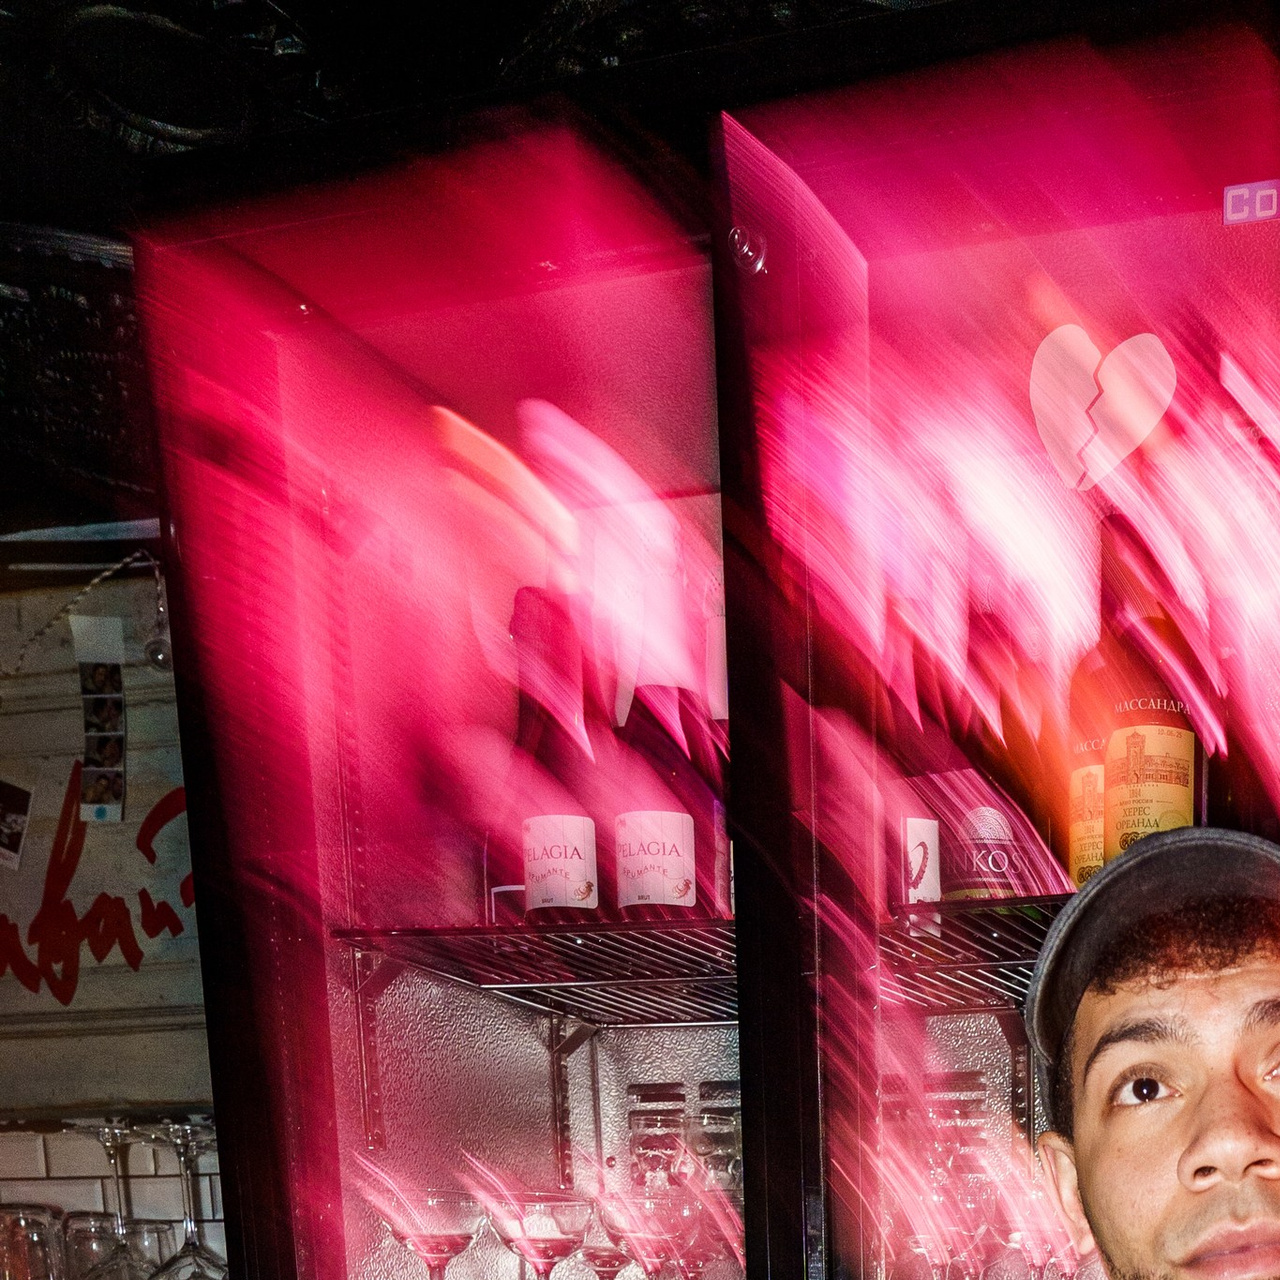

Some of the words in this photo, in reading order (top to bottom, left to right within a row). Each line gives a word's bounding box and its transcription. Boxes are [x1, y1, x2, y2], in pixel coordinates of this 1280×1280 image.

[1122, 806, 1151, 818] ХЕРЕС
[1116, 818, 1160, 831] ОРЕАНДА
[617, 841, 683, 859] PELAGIA
